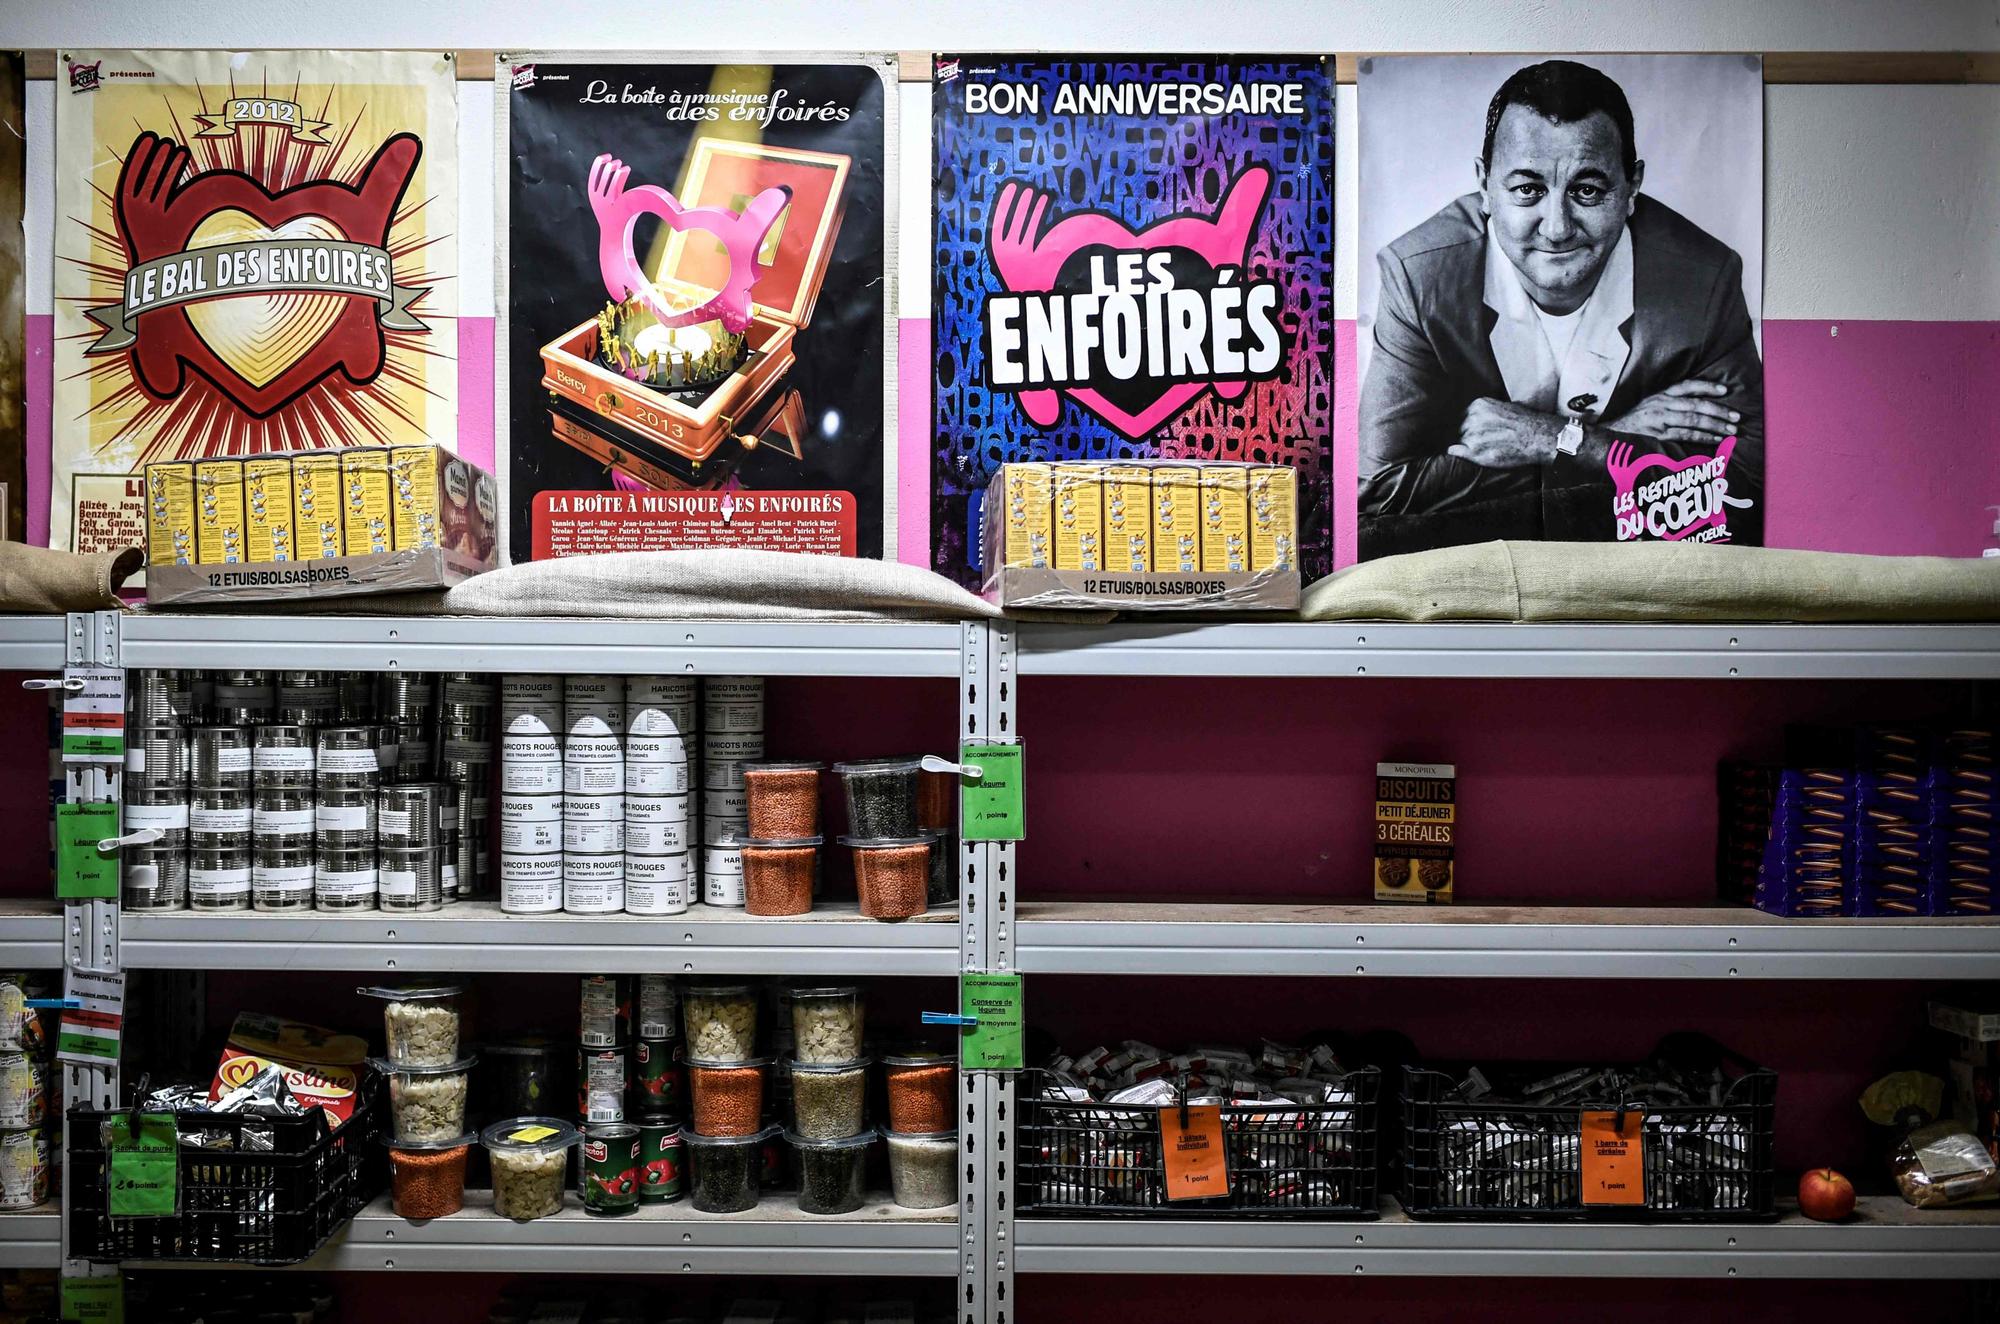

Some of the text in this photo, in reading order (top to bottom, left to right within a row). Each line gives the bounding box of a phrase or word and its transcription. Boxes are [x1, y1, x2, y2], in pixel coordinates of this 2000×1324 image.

[579, 79, 768, 108] La boîte à musique
[965, 83, 1304, 115] BON ANNIVERSAIRE
[234, 100, 295, 122] 2012
[666, 89, 850, 130] des enfoirés
[128, 246, 390, 310] LE BAL DES ENFOIRÉS
[1090, 252, 1175, 297] LES
[988, 270, 1281, 385] ENFOIRÉS
[556, 369, 587, 395] Bercy
[634, 405, 685, 438] 2013
[1613, 455, 1726, 516] LES RESTAURANTS
[79, 501, 108, 510] Alizée
[548, 493, 842, 516] LA BOÎTE À MUSIQUE ENFOIRÉS
[79, 510, 122, 519] Benzéma
[79, 519, 135, 528] Foly Garou
[576, 520, 594, 528] Agnel
[599, 519, 617, 527] Alizée
[1616, 511, 1644, 541] DU
[79, 527, 143, 537] Michael Jones
[577, 528, 608, 536] Canteloup
[78, 536, 134, 545] Le Forestier
[798, 535, 815, 543] Jones
[641, 543, 666, 551] Laroque
[208, 573, 221, 587] 12
[1083, 580, 1226, 595] 12 ETUIS/BOLSAS/BOXES
[574, 684, 606, 692] ROUGES
[533, 743, 562, 751] ROUGES
[595, 744, 624, 752] ROUGES
[1394, 766, 1436, 774] MONOPRIX
[979, 780, 1006, 788] Légume
[1378, 780, 1452, 800] BISCUITS
[505, 803, 533, 811] ROUGES
[570, 802, 601, 810] ROUGES
[631, 803, 662, 811] ROUGES
[1379, 805, 1450, 819] PETIT DÉJEUNER
[1378, 821, 1451, 843] 3 CÉRÉALES
[534, 860, 562, 869] ROUGES
[593, 860, 622, 870] ROUGES
[76, 871, 100, 880] 1 point
[72, 972, 122, 985] PRODUITS MIXTES
[971, 998, 1013, 1007] Conserve de
[978, 1006, 1006, 1014] légumes
[981, 1052, 985, 1060] 1
[114, 1144, 141, 1152] Sachet
[1185, 1174, 1209, 1183] 1 point
